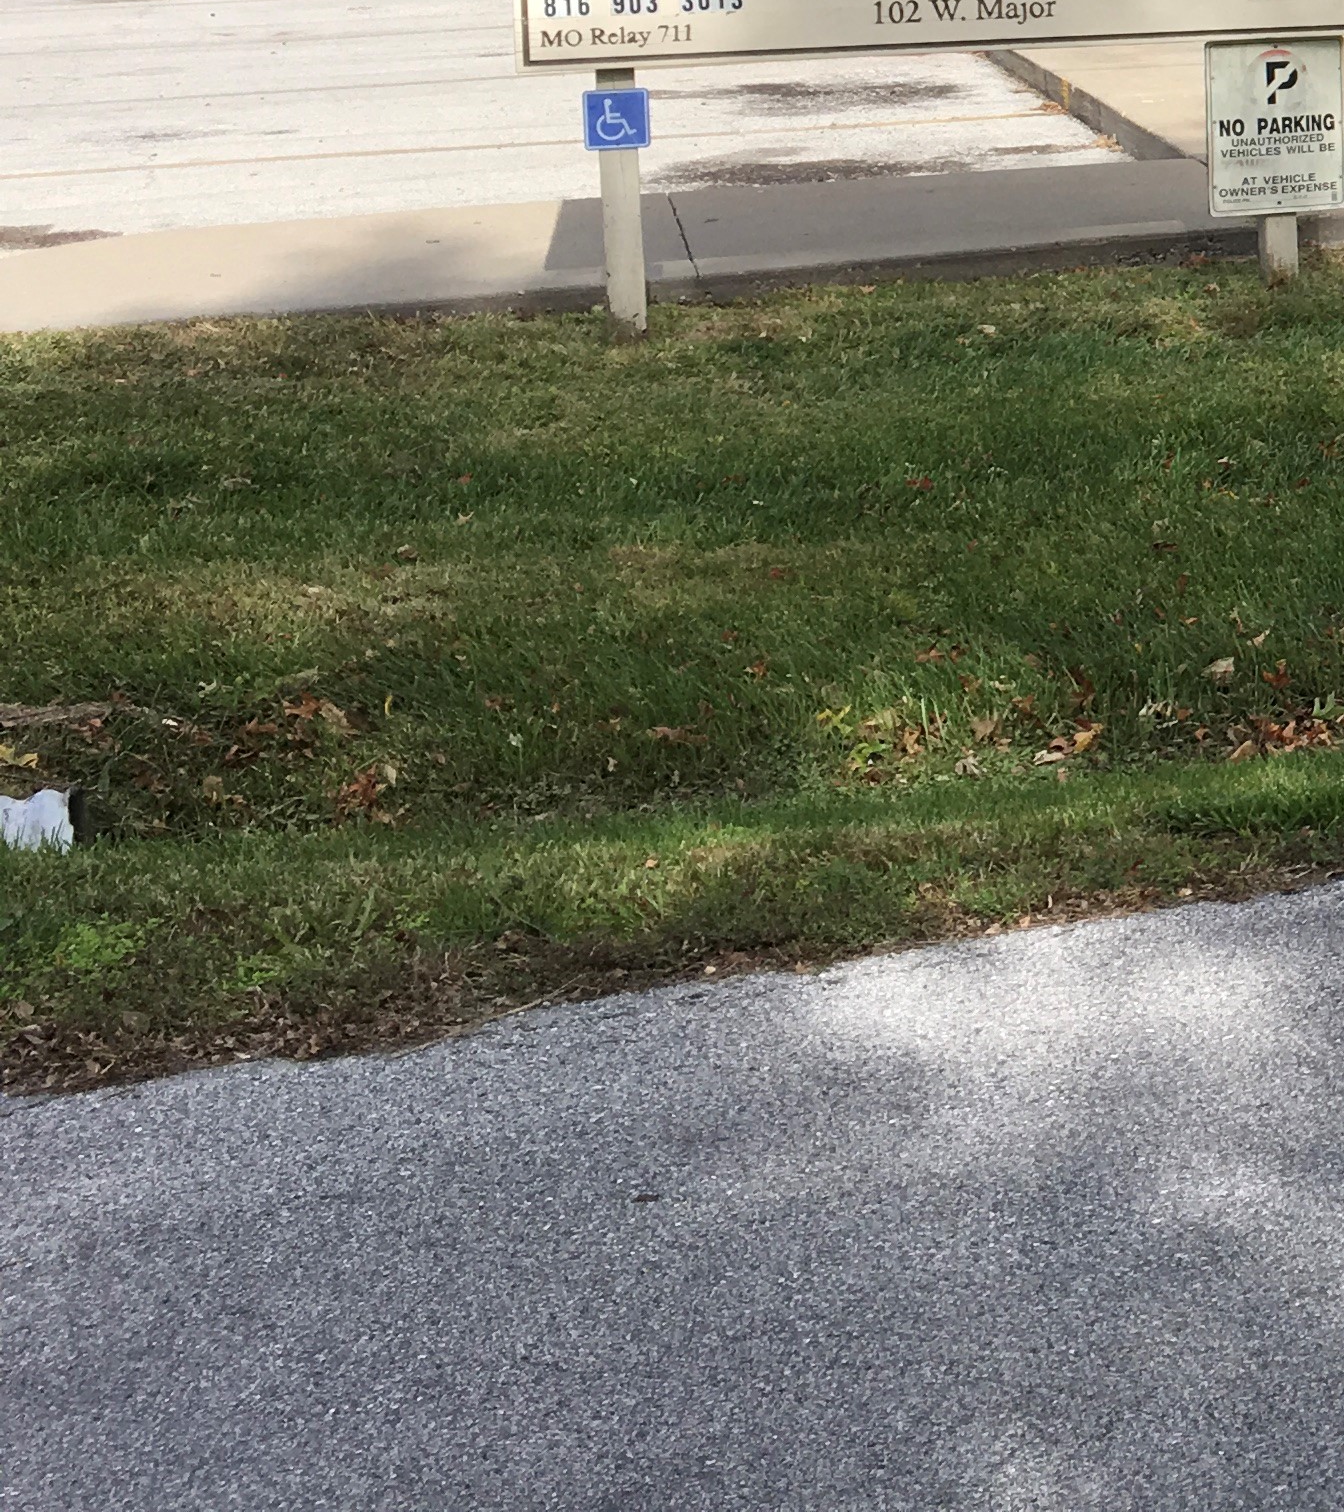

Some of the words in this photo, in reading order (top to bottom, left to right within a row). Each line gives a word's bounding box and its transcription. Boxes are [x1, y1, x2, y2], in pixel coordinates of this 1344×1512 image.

[873, 0, 922, 25] 102
[540, 29, 583, 48] MO
[590, 26, 651, 48] Relay
[657, 24, 692, 42] 711
[1219, 119, 1245, 137] NO
[1257, 113, 1335, 136] PARKING
[1231, 133, 1325, 148] UNAUTHORIZED
[1220, 146, 1281, 158] VEHICLES
[1286, 144, 1315, 155] WILL
[1319, 142, 1336, 152] BE
[1241, 176, 1258, 186] AT
[1263, 172, 1317, 185] VEHICLE
[1218, 185, 1279, 198] OWNER'S
[1281, 181, 1338, 194] EXPENSE
